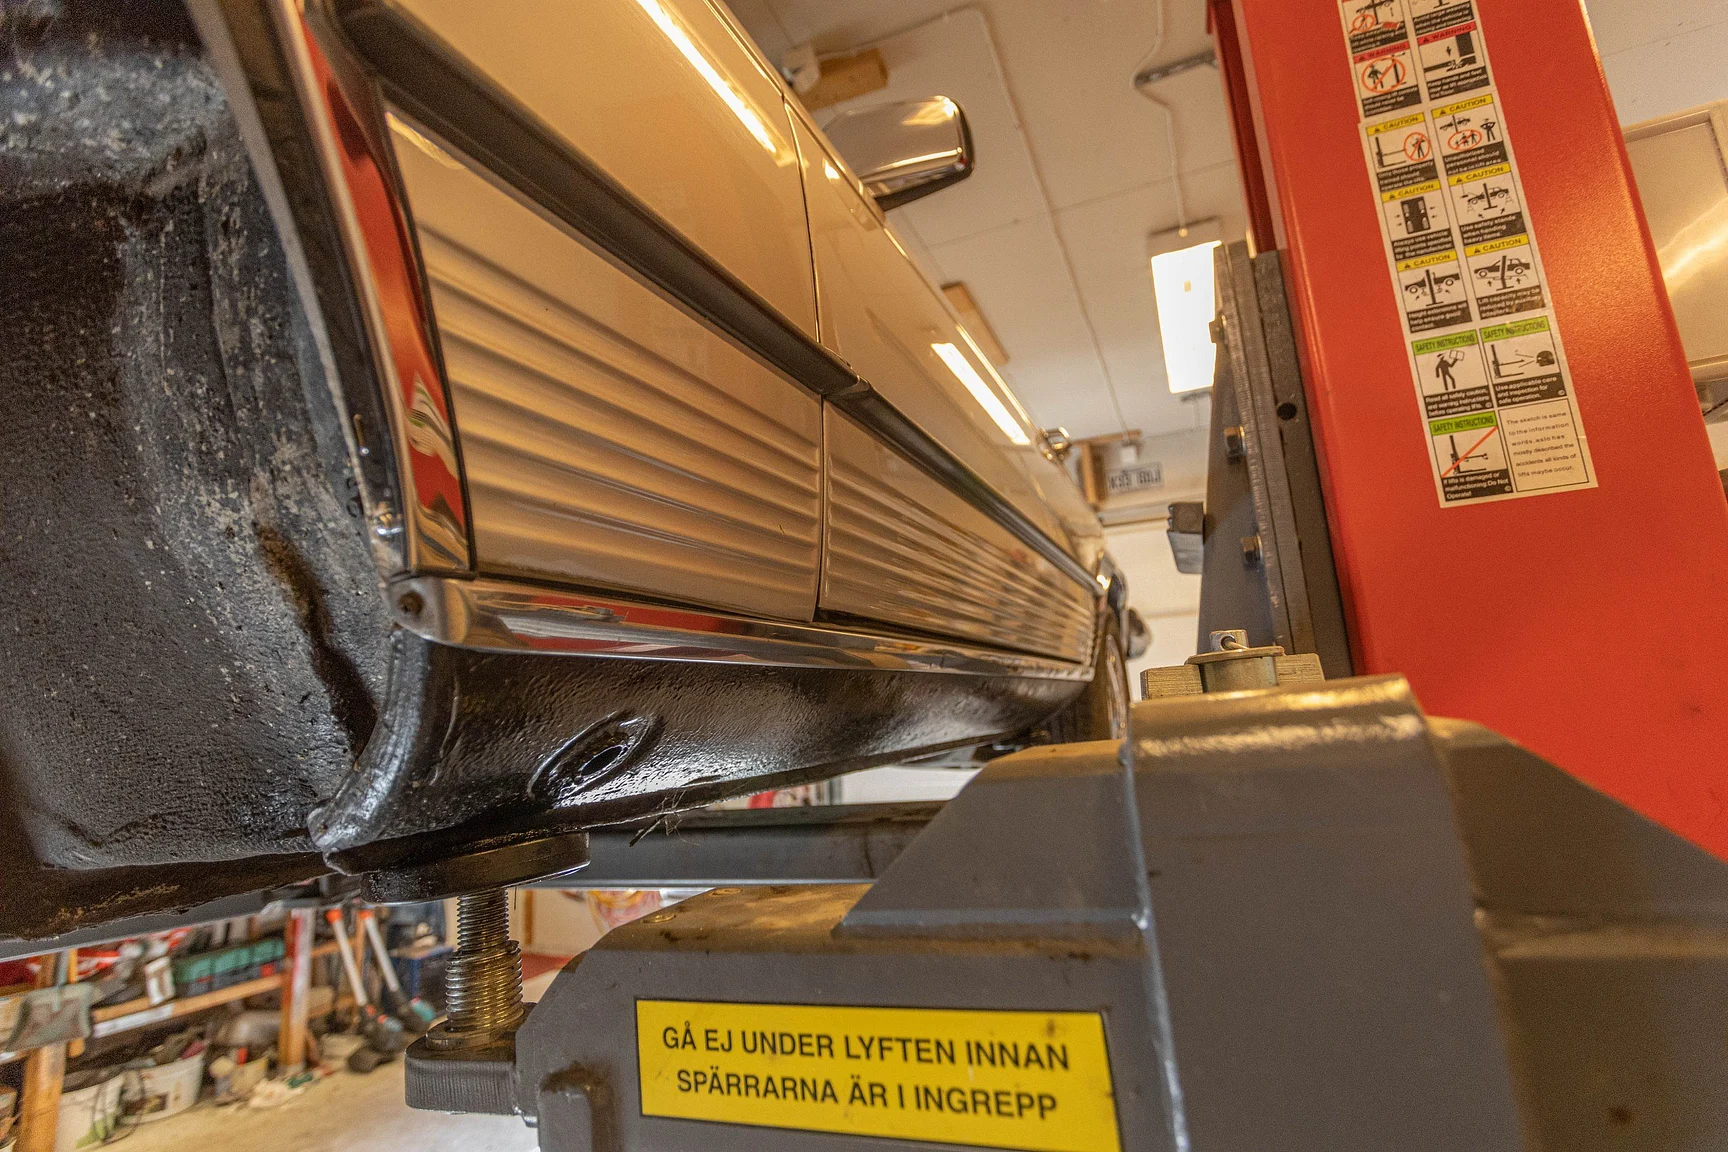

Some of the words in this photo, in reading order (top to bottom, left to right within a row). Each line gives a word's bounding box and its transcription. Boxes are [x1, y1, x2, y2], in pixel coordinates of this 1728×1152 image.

[1431, 23, 1471, 40] WARNING
[1448, 97, 1486, 112] CAUTION
[1382, 115, 1418, 129] CAUTION
[1465, 166, 1504, 180] CAUTION
[1397, 183, 1434, 196] CAUTION
[1481, 237, 1521, 251] CAUTION
[1413, 253, 1451, 266] CAUTION
[1482, 327, 1504, 339] SAFETY
[1504, 319, 1545, 335] INSTRUCTIONS
[1414, 340, 1436, 352] SAFETY
[1436, 333, 1475, 348] INSTRUCTIONS
[1507, 378, 1542, 389] applicable
[1541, 375, 1557, 384] care
[1425, 395, 1441, 403] Read
[1448, 391, 1465, 399] safety
[1496, 390, 1509, 398] and
[1508, 385, 1539, 395] inspection
[1497, 397, 1512, 405] safe
[1445, 404, 1471, 414] operating
[1431, 421, 1454, 432] SAFETY
[1453, 415, 1493, 429] INSTRUCTIONS
[1519, 415, 1540, 423] sketch
[1528, 422, 1569, 432] information
[1512, 449, 1533, 457] mostly
[1532, 444, 1563, 454] described
[1514, 457, 1543, 466] accidents
[1530, 467, 1553, 476] maybe
[1553, 464, 1574, 473] occur.
[1464, 472, 1493, 482] damaged
[663, 1021, 696, 1051] GÅ
[705, 1029, 732, 1052] EJ
[742, 1030, 834, 1059] UNDER
[844, 1035, 955, 1065] LYFTEN
[967, 1040, 1069, 1070] INNAN
[676, 1067, 838, 1103] SPÄRRARNA
[849, 1076, 887, 1107] ÄR
[899, 1083, 906, 1108] I
[914, 1085, 1057, 1120] INGREPP
